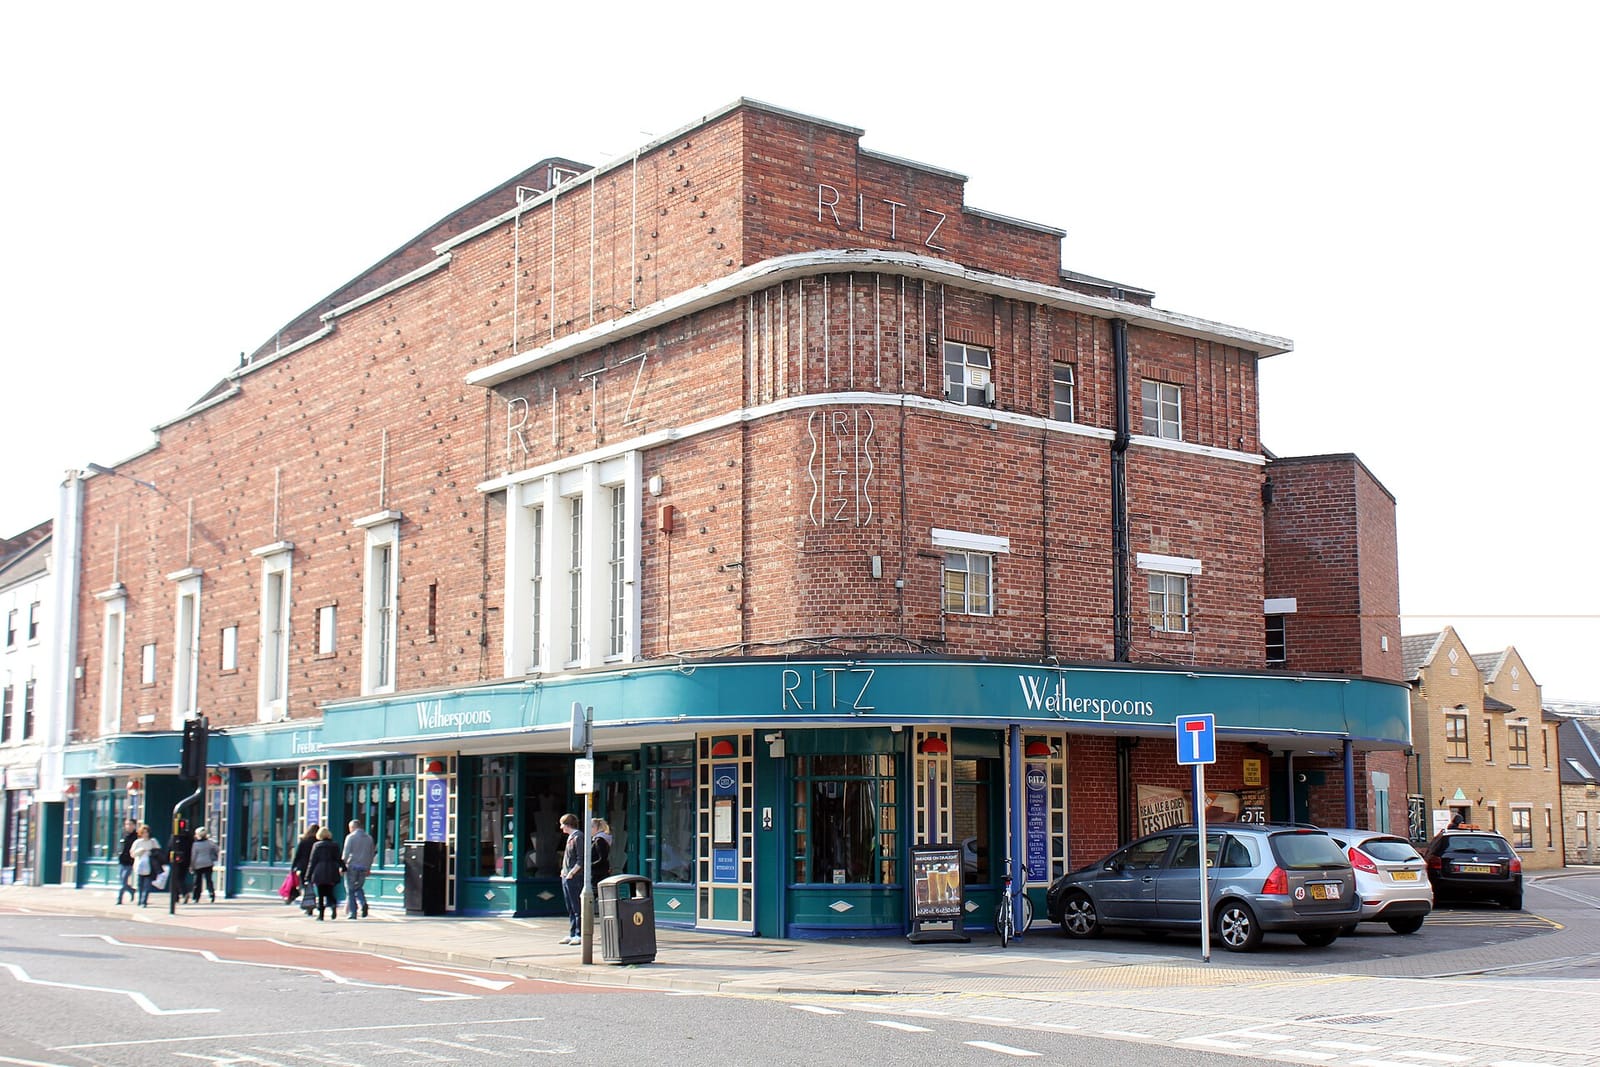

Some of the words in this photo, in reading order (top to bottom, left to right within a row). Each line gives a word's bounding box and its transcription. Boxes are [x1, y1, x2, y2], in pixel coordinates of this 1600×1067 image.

[818, 183, 947, 251] RITZ
[506, 351, 649, 460] RITZ
[831, 411, 849, 521] RITZ
[782, 667, 876, 711] RITZ
[1018, 674, 1153, 721] Wetherspoons
[416, 699, 492, 732] Wetherspoons
[1028, 775, 1045, 784] RITZ
[1141, 808, 1184, 836] FESTIVAL
